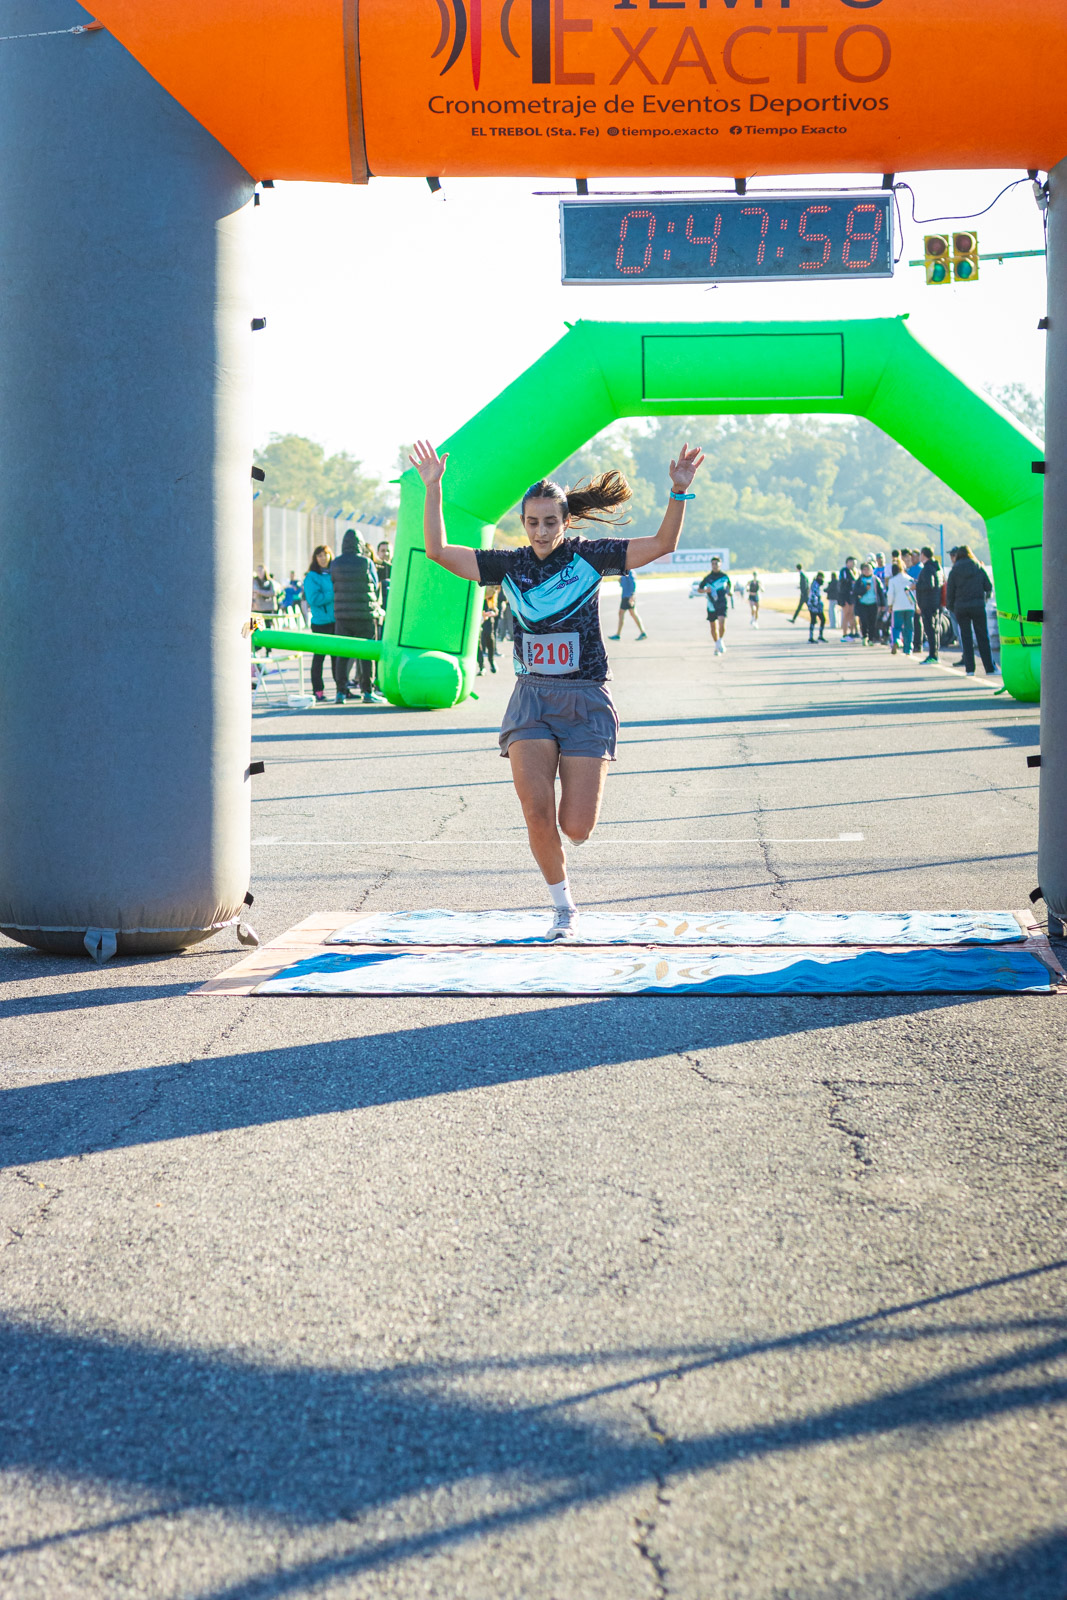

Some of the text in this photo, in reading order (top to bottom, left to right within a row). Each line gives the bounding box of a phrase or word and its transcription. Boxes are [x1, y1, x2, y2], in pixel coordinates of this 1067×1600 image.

[427, 93, 890, 118] Cronometraje de Eventos Deportivos
[471, 127, 487, 136] EL
[489, 127, 543, 136] TREBOL
[546, 126, 576, 138] (Sta.
[579, 126, 600, 138] Fe)
[745, 125, 798, 136] Tiempo
[801, 124, 848, 135] Exacto
[615, 204, 883, 275] 0:47:58
[533, 642, 569, 665] 210
